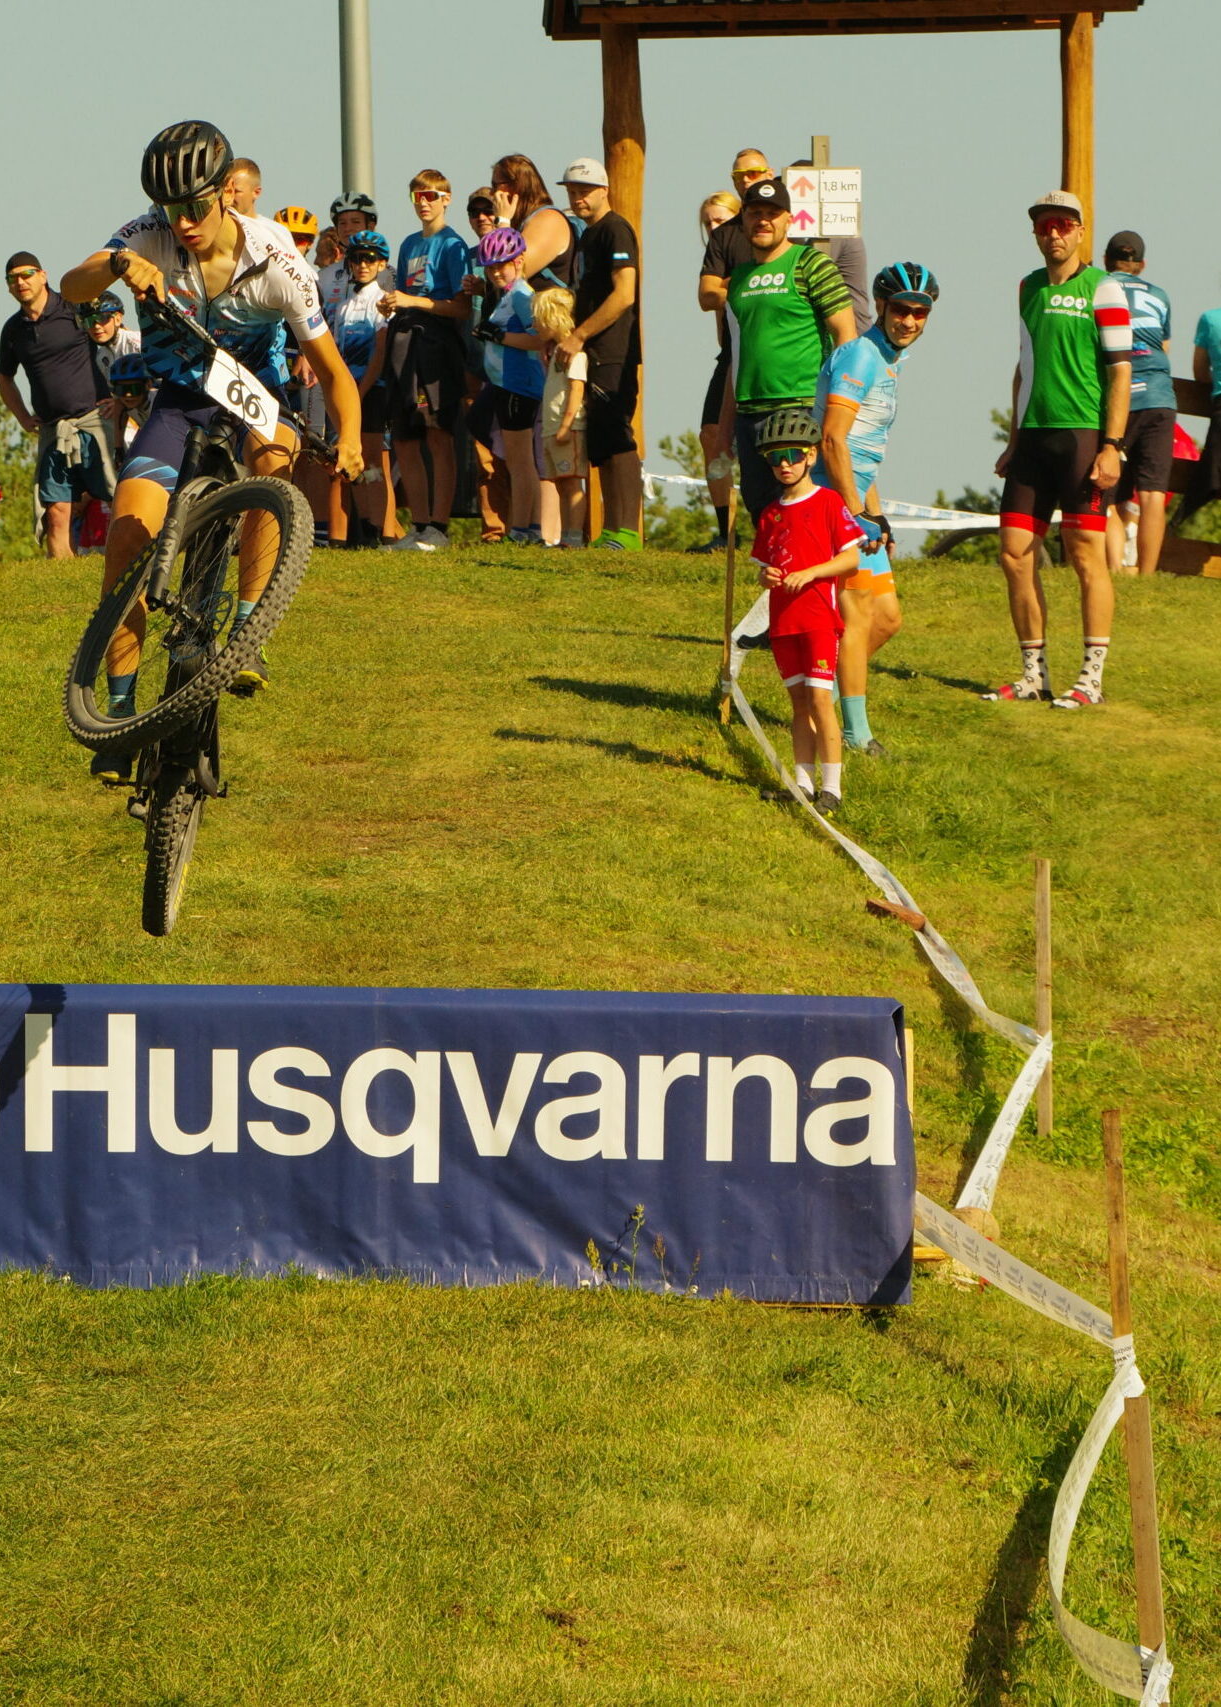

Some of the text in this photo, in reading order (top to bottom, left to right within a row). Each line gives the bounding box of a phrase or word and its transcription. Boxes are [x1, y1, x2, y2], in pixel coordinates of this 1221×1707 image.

[823, 181, 858, 192] 1,8 km
[824, 213, 856, 224] 2,7 km
[226, 379, 261, 419] 66
[24, 1012, 896, 1184] Husqvarna
